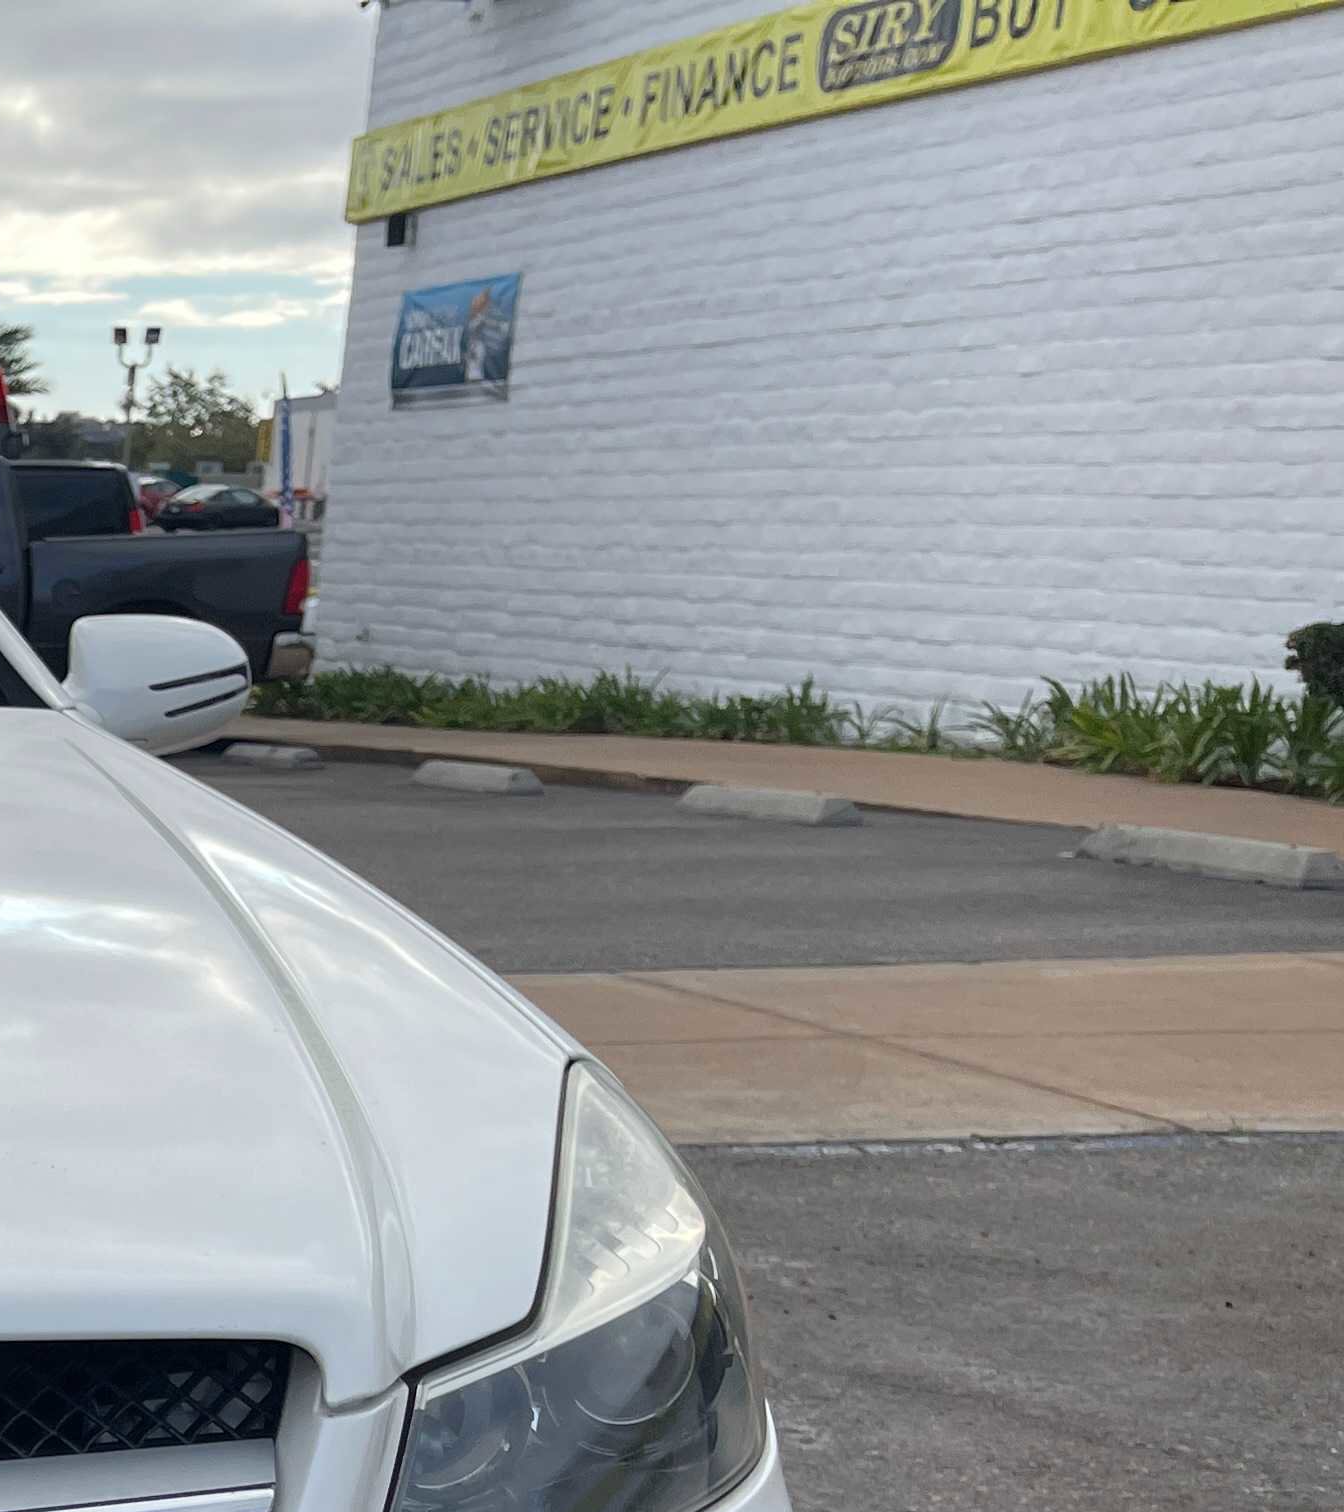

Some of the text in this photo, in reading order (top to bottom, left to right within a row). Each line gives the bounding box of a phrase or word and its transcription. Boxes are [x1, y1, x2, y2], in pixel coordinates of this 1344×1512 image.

[380, 128, 463, 192] SALES
[484, 87, 615, 167] SERVICE
[640, 33, 803, 126] FINANCE
